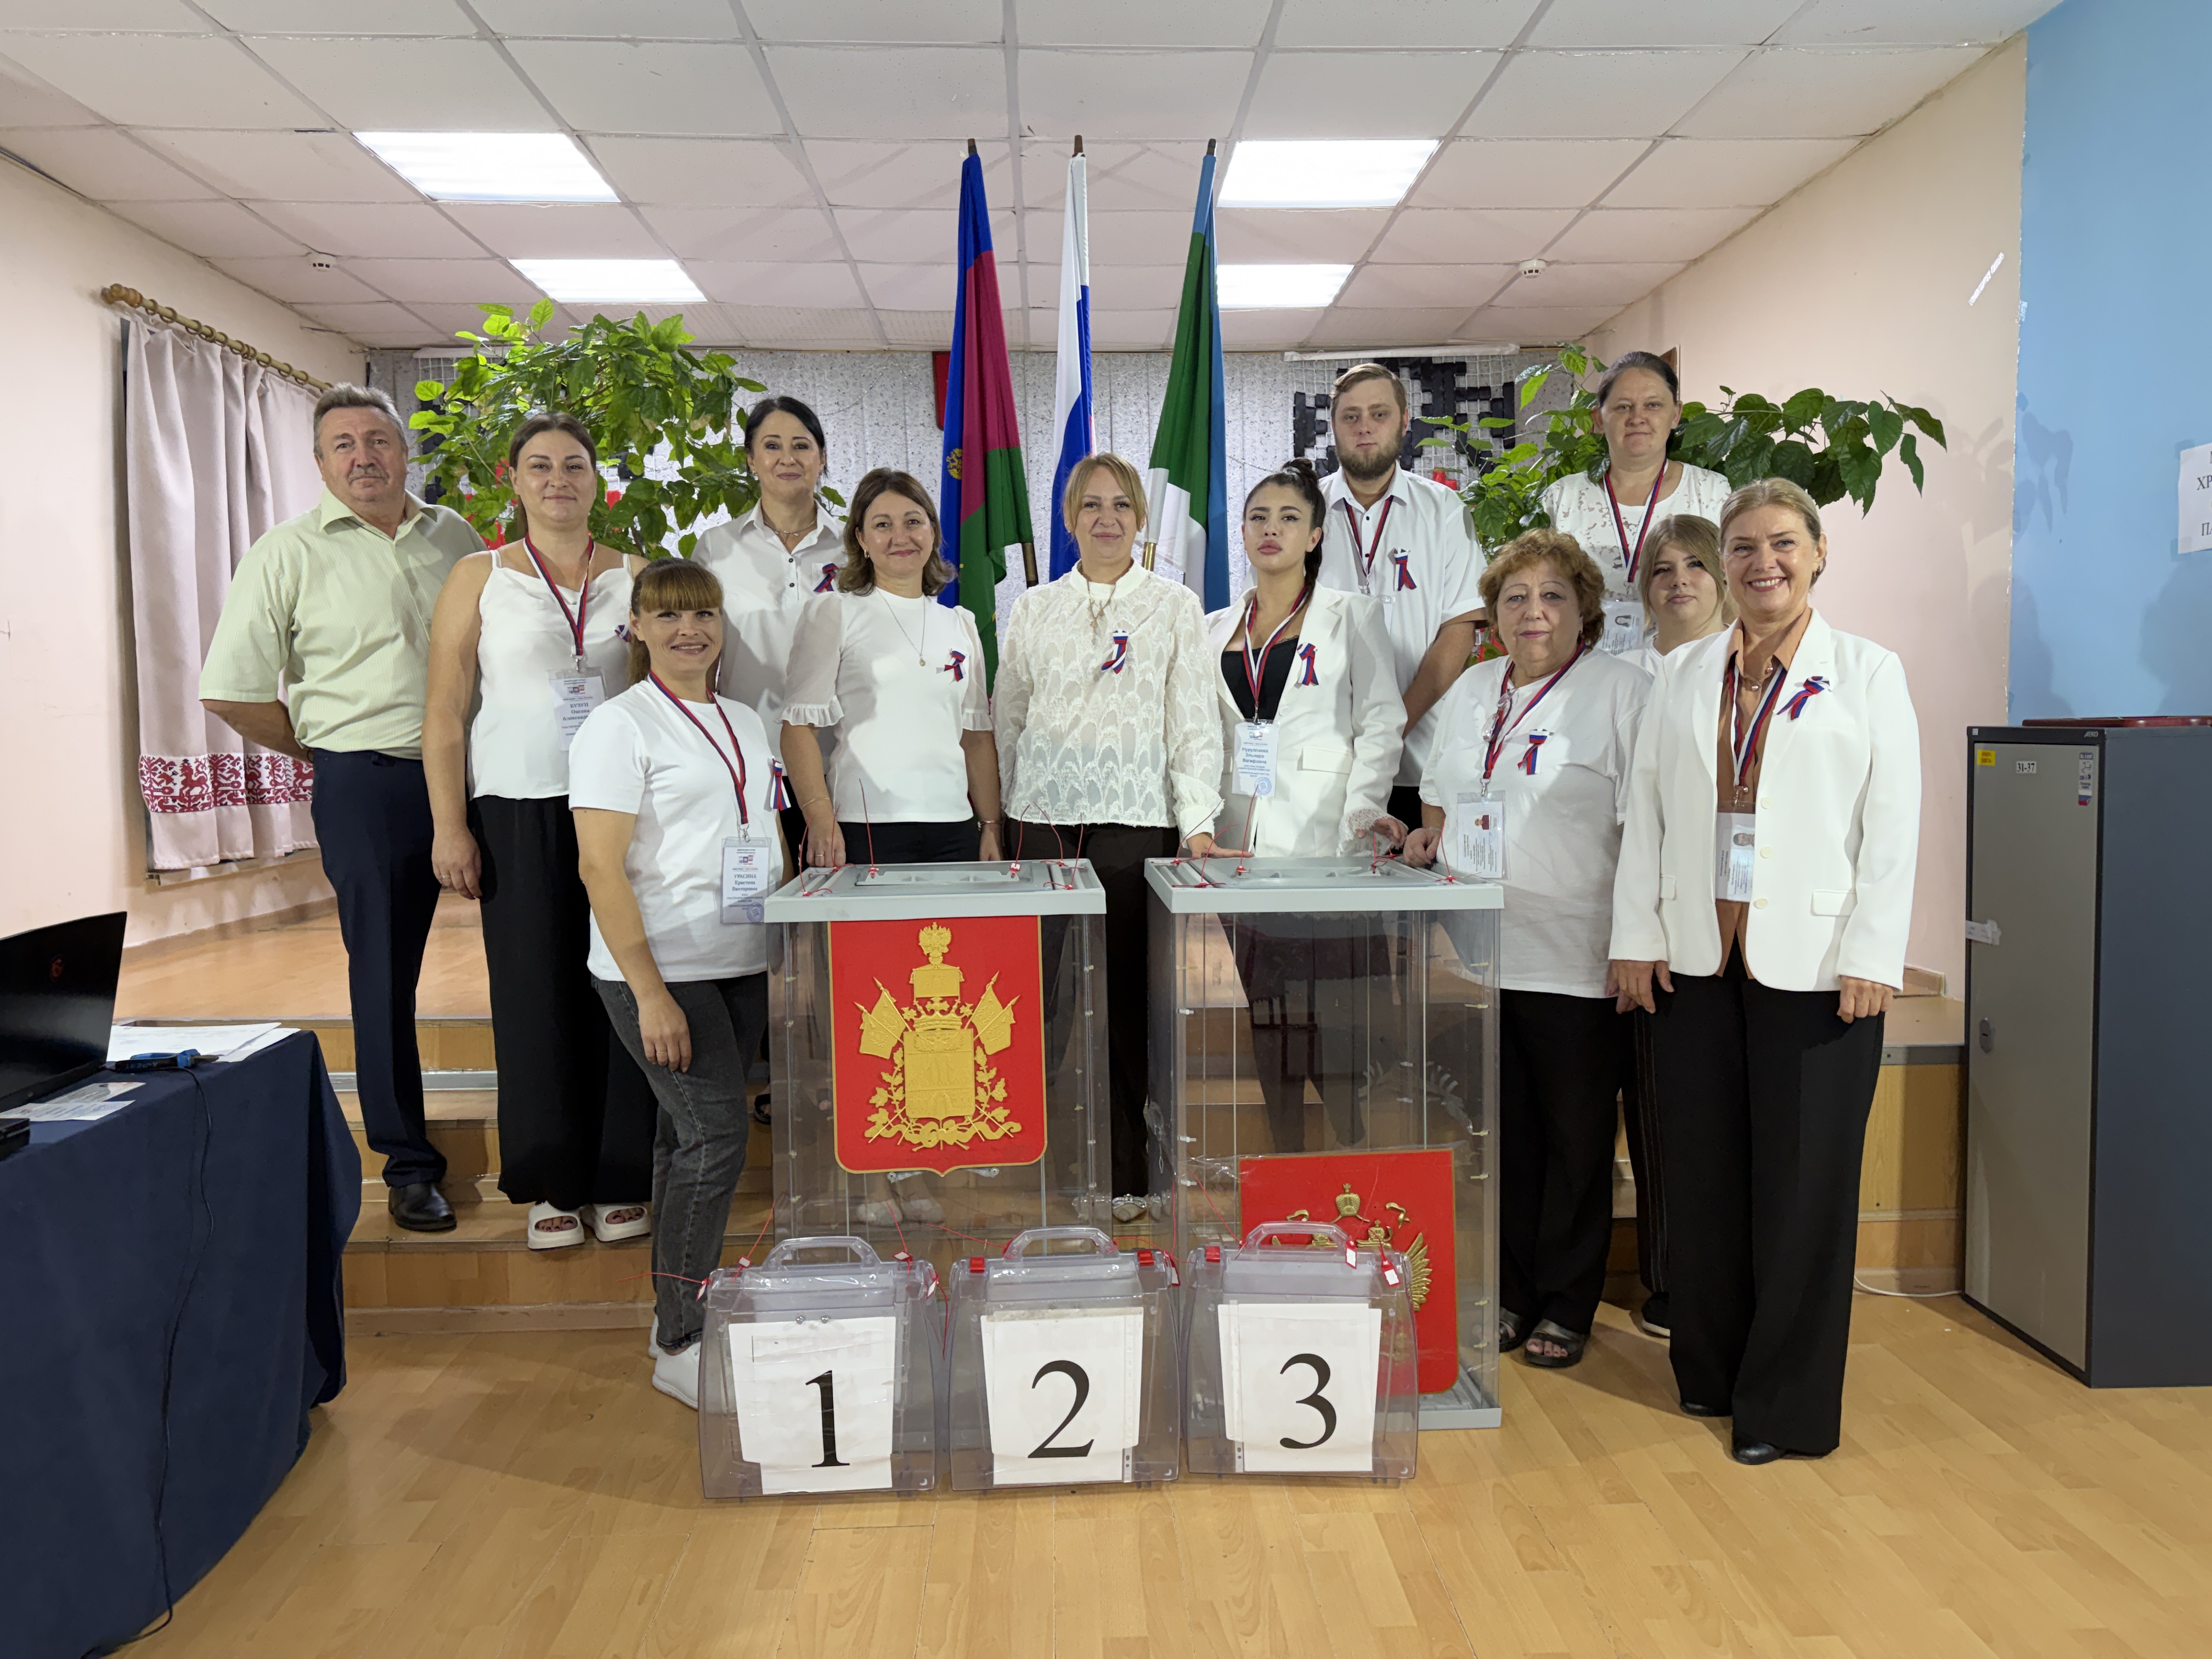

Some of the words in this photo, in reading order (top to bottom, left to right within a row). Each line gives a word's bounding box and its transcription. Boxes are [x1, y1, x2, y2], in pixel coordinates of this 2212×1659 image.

[2017, 763, 2035, 772] 31-37
[805, 1370, 850, 1468] 1
[1028, 1360, 1094, 1459] 2
[1279, 1353, 1337, 1449] 3
